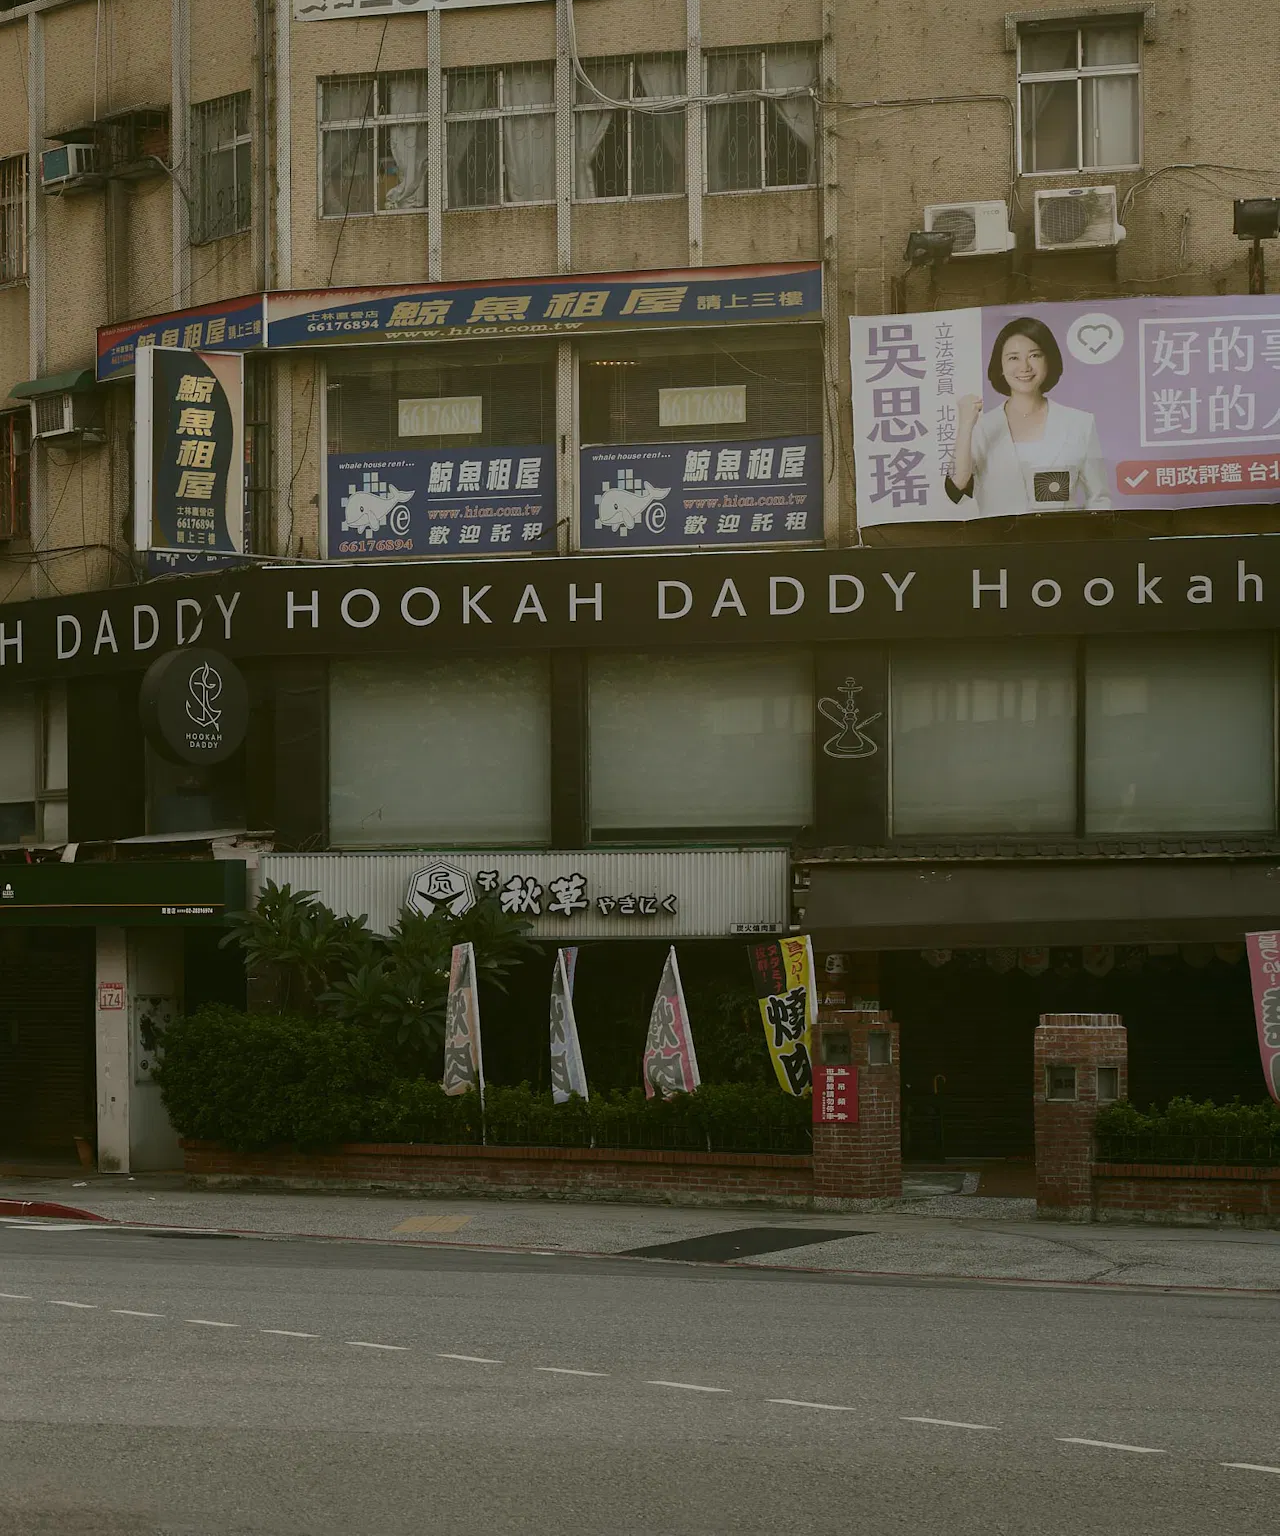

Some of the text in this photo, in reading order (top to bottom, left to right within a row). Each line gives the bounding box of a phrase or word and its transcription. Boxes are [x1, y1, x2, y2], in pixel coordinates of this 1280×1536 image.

[385, 284, 689, 327] 鯨魚租屋
[696, 290, 804, 311] 請上三樓
[307, 319, 379, 333] 66176894
[384, 321, 585, 340] www.hion.com.tw
[935, 322, 957, 478] 立法委員 北投天母
[400, 401, 480, 433] 66176894
[865, 324, 930, 508] 吳思瑤
[175, 374, 217, 500] 鯨魚租屋
[339, 462, 362, 470] whale
[363, 461, 387, 469] house
[592, 454, 616, 462] whale
[617, 452, 642, 461] house
[682, 445, 807, 483] 鯨魚租屋
[427, 457, 542, 493] 鯨魚租屋
[1156, 462, 1243, 487] 問政評鑑
[682, 492, 808, 510] www.hion.com.tw
[427, 504, 543, 521] www.hion.com.tw
[683, 511, 808, 535] 歡迎託租
[176, 518, 215, 530] 66176894
[428, 522, 543, 545] 歡迎託租
[176, 530, 216, 545] 請上三樓
[339, 538, 414, 553] 66176894
[971, 559, 1265, 611] Hookah
[285, 570, 918, 630] HOOKAH DADDY
[55, 591, 241, 661] DADDY
[184, 732, 223, 742] HOOKAH
[189, 740, 219, 749] DADDY
[596, 894, 677, 915] やきにく
[102, 993, 121, 1007] 174
